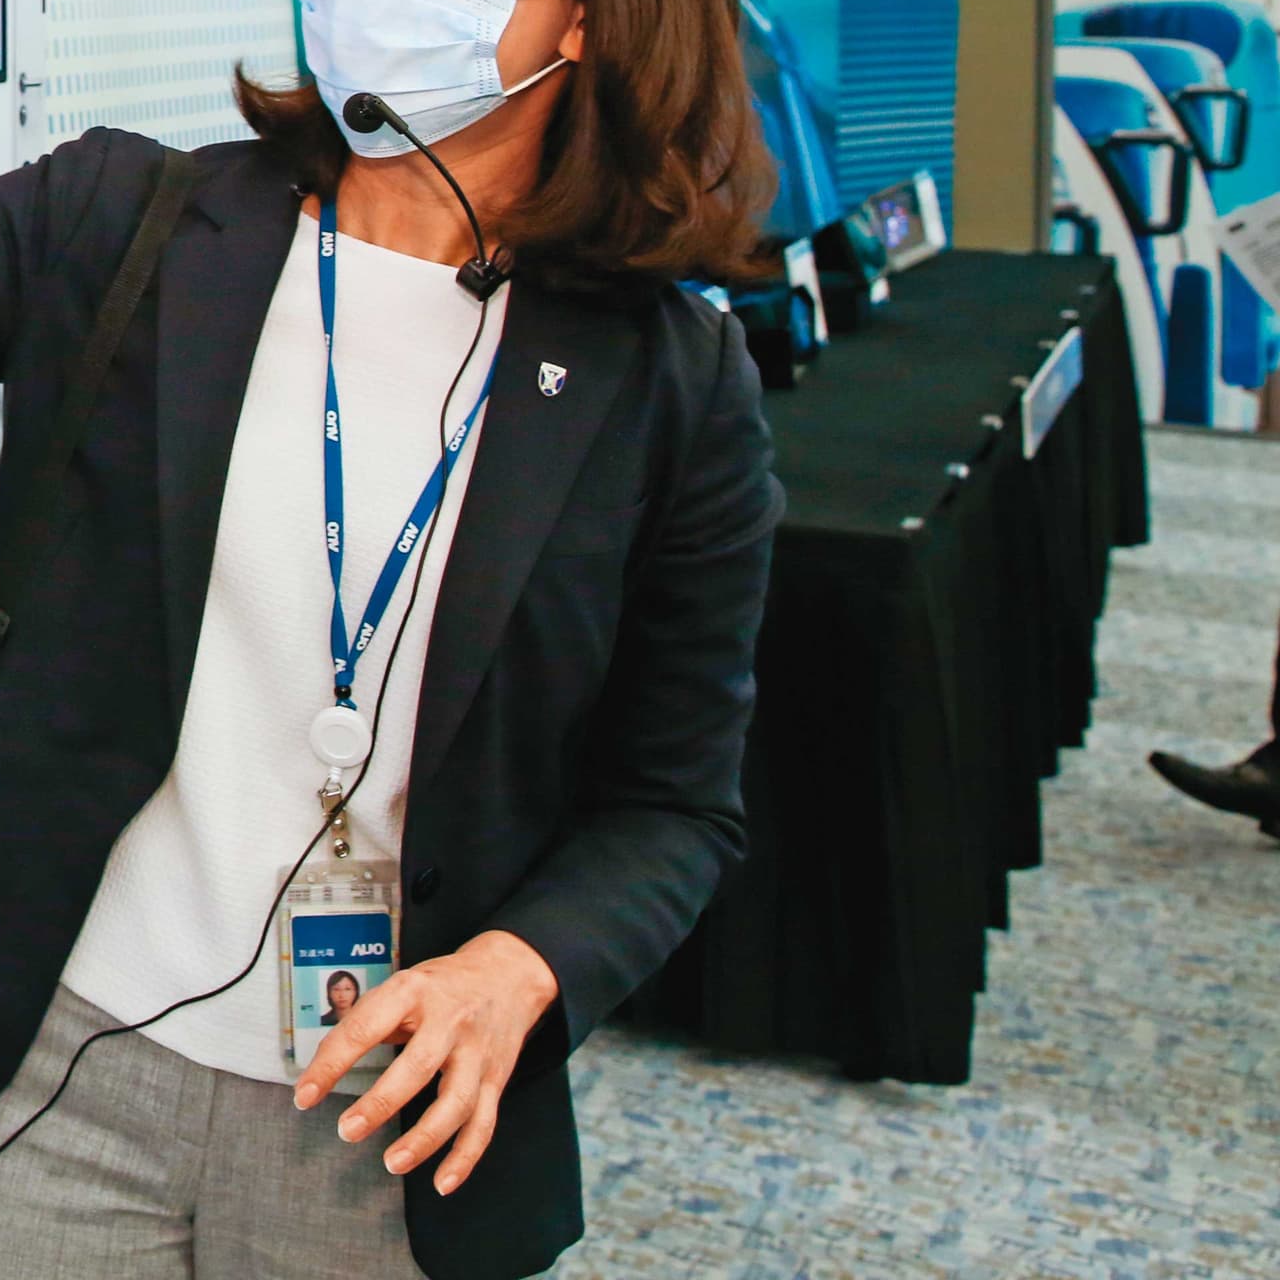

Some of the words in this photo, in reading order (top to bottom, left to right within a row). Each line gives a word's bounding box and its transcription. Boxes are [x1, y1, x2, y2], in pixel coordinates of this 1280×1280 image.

[321, 231, 335, 257] AUO
[326, 410, 339, 442] AUO
[327, 521, 340, 552] AUO
[397, 521, 420, 553] AUO
[356, 622, 374, 651] AUO
[350, 942, 386, 957] AUO
